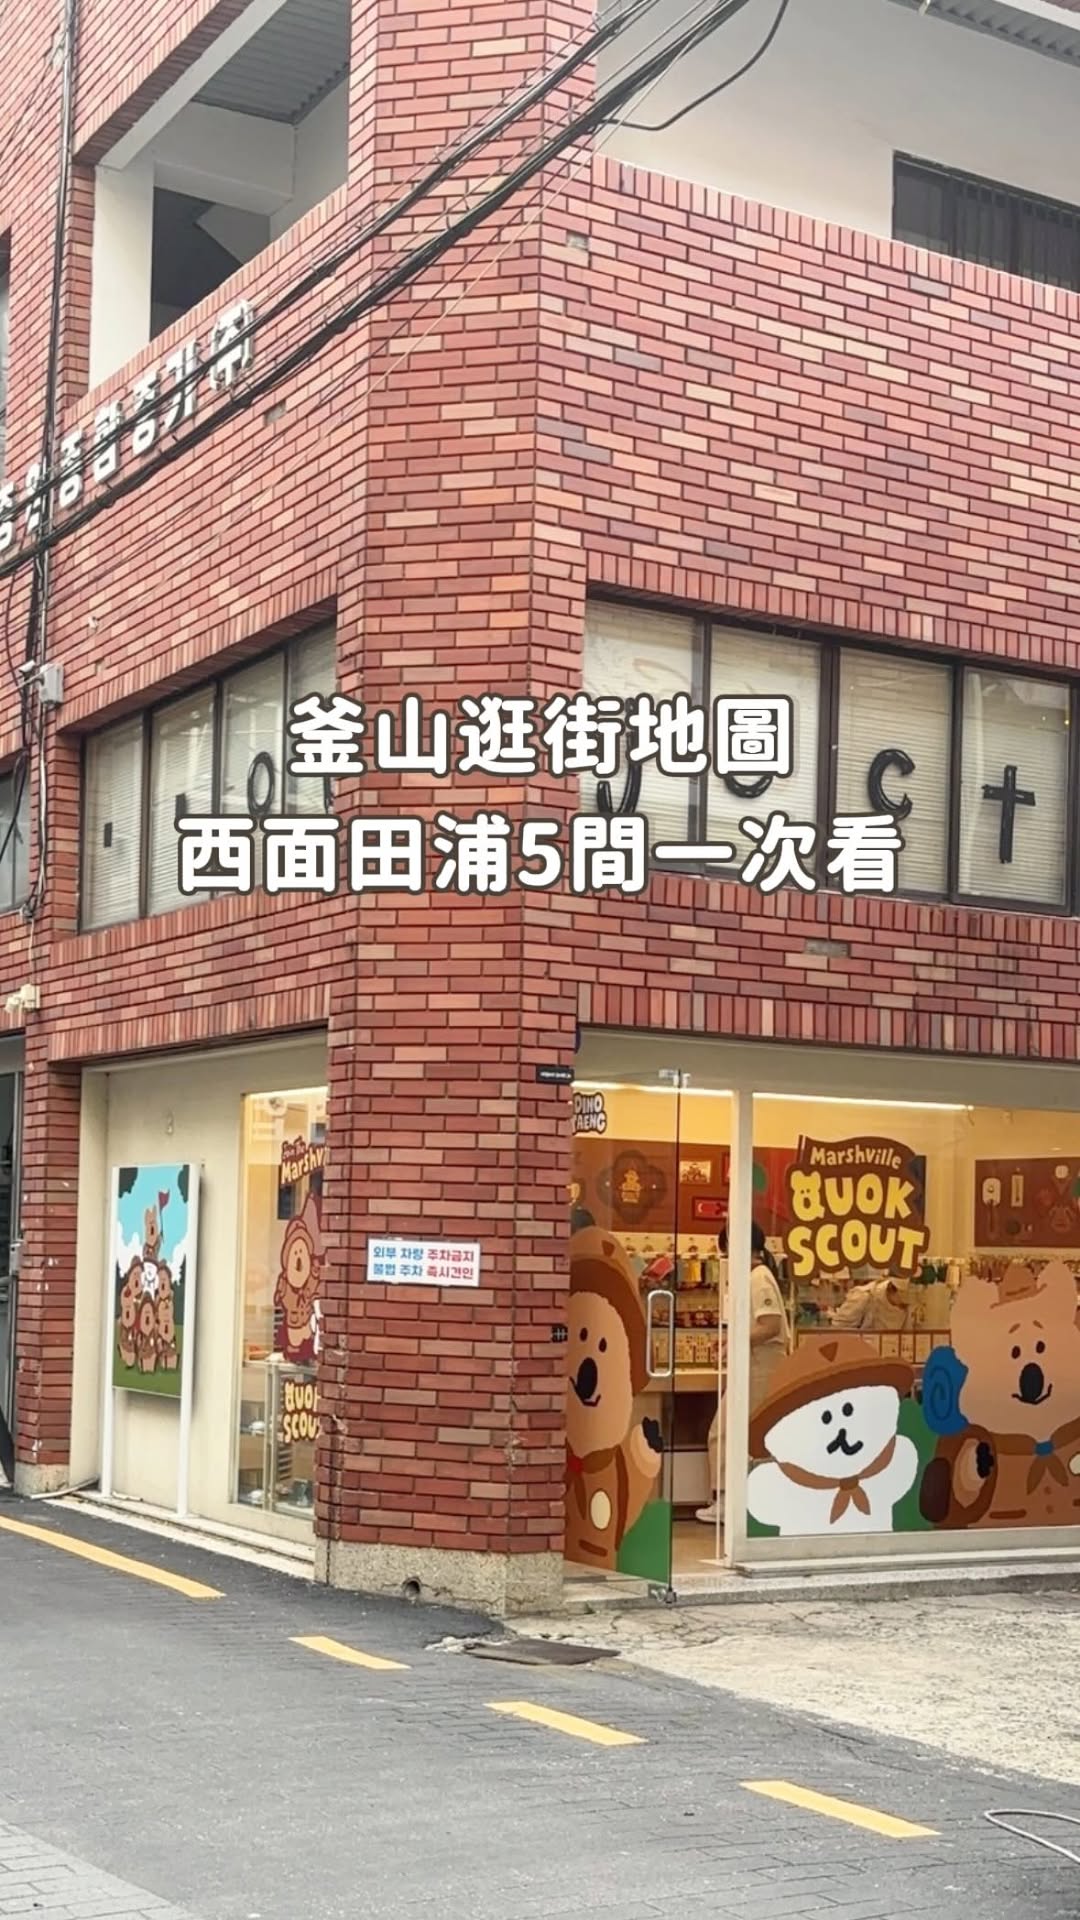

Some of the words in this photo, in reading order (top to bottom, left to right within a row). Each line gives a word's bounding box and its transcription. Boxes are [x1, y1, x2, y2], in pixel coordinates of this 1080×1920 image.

[574, 1094, 603, 1114] DINO
[810, 1144, 902, 1170] Marshville
[790, 1170, 914, 1221] QUOK
[373, 1246, 396, 1259] 외부
[400, 1247, 424, 1261] 차량
[427, 1249, 474, 1262] 주차금지
[787, 1219, 925, 1277] SCOUT
[373, 1263, 396, 1276] 불법
[400, 1264, 423, 1277] 주차
[426, 1266, 474, 1280] 즉시견인
